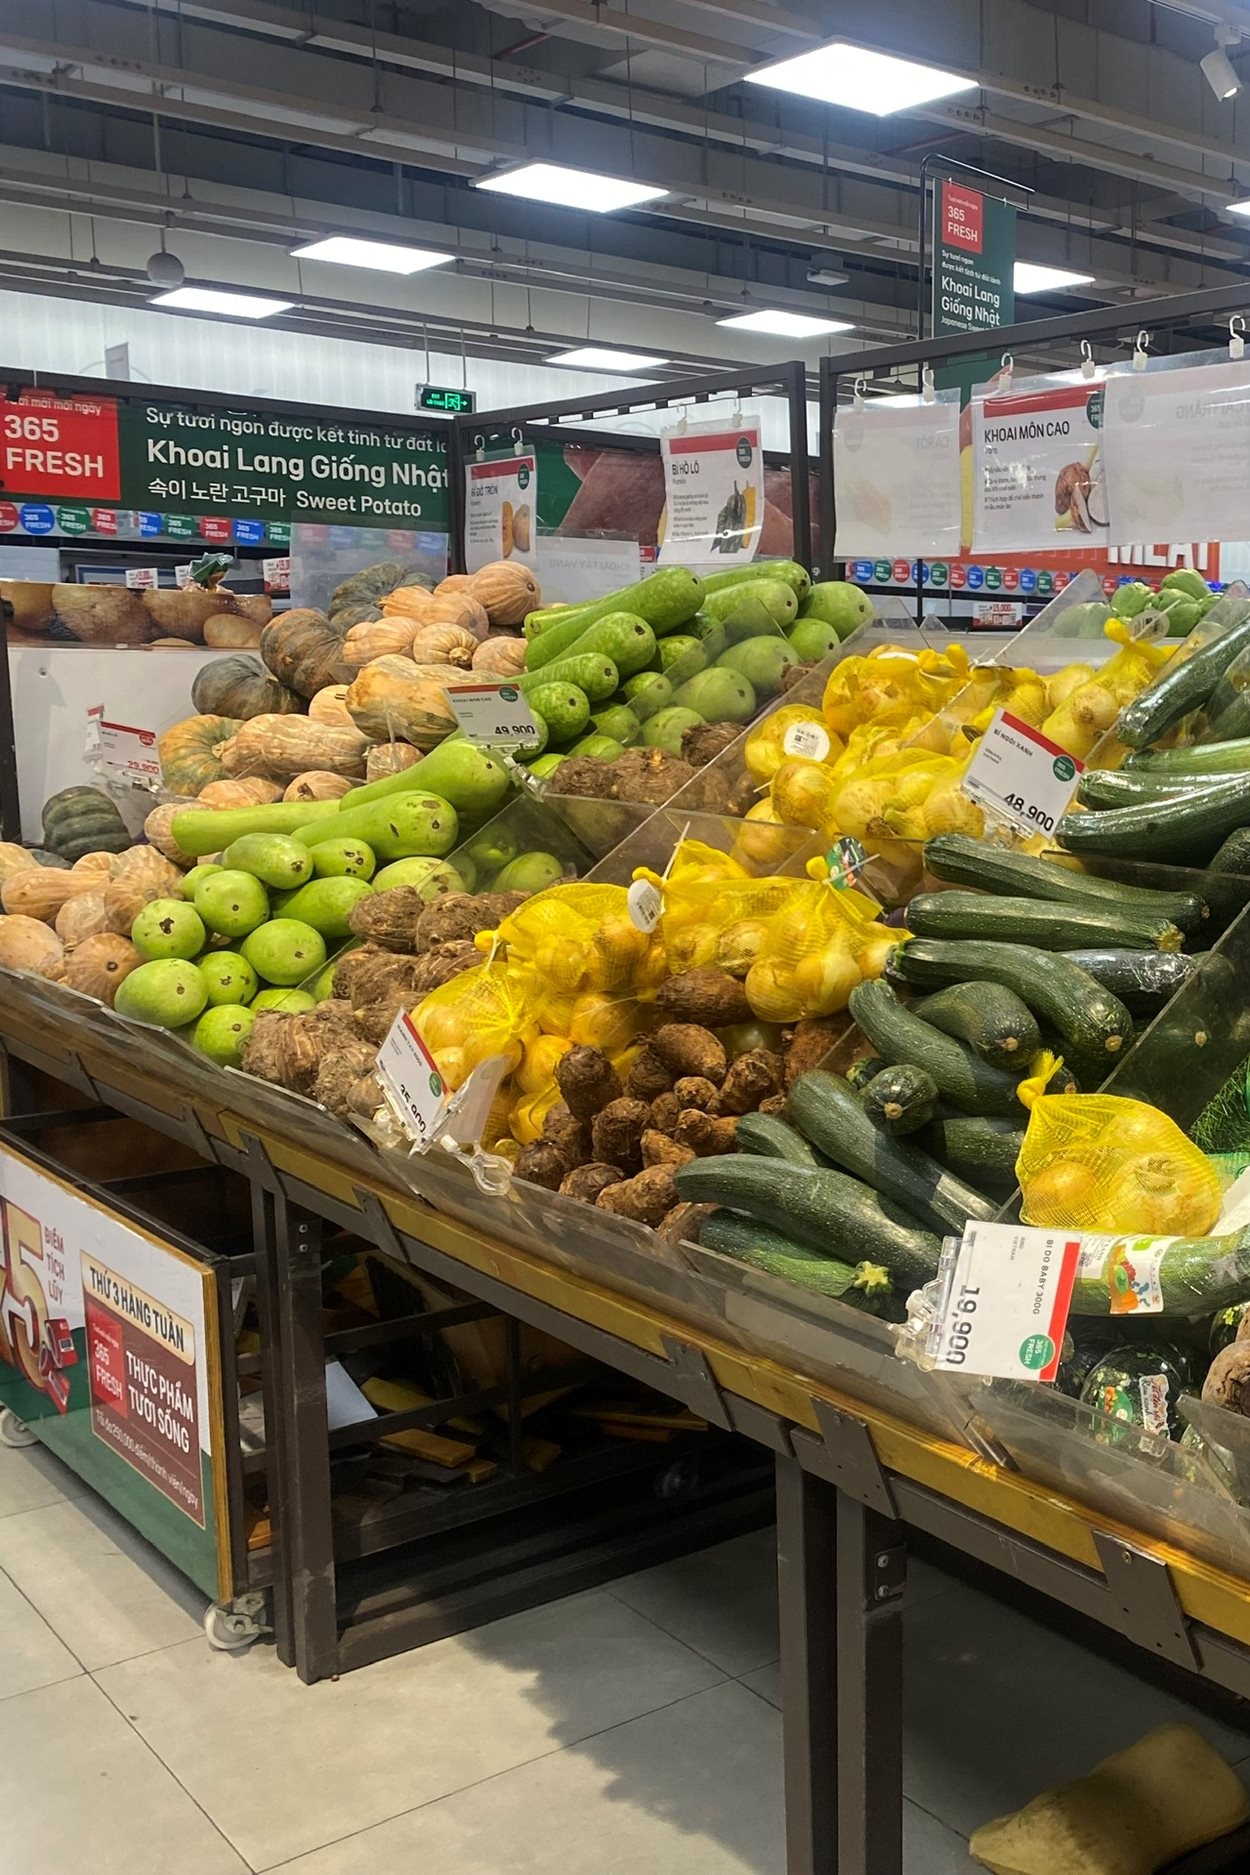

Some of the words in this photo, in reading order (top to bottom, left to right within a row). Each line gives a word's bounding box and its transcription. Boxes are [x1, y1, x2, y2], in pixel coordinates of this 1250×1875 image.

[948, 205, 965, 221] 365
[948, 221, 978, 242] FRESH
[942, 275, 973, 297] Khoai
[975, 285, 1000, 308] Lang
[941, 296, 973, 321] Giống
[975, 305, 1000, 328] Nhật
[4, 415, 59, 442] 365
[146, 407, 173, 428] Sự
[177, 412, 215, 430] tươi
[220, 418, 264, 436] ngon
[268, 420, 313, 442] được
[984, 426, 1017, 443] KHOAI
[1019, 421, 1045, 441] MÔN
[1047, 421, 1070, 437] CAO
[6, 447, 104, 478] FRESH
[147, 439, 230, 469] Khoai
[237, 447, 304, 481] Lang
[311, 454, 385, 488] Giống
[392, 462, 448, 493] Nhật
[148, 478, 186, 500] 속이
[190, 482, 229, 503] 노란
[231, 485, 287, 508] 고구마
[296, 490, 356, 512] Sweet
[361, 496, 422, 517] Potato
[1004, 793, 1055, 832] 48,900
[1037, 1265, 1049, 1290] BABY
[90, 1266, 111, 1299] THỨ
[113, 1282, 119, 1306] 3
[121, 1285, 151, 1328] HÀNG
[152, 1309, 184, 1353] TUẦN
[1032, 1291, 1044, 1315] 300G
[946, 1285, 980, 1365] 19,900
[1024, 1338, 1035, 1365] FRESH
[96, 1365, 123, 1401] FRESH
[126, 1350, 158, 1395] THỰC
[159, 1374, 194, 1423] PHẨM
[128, 1383, 157, 1428] TƯƠI
[158, 1407, 189, 1454] SỐNG
